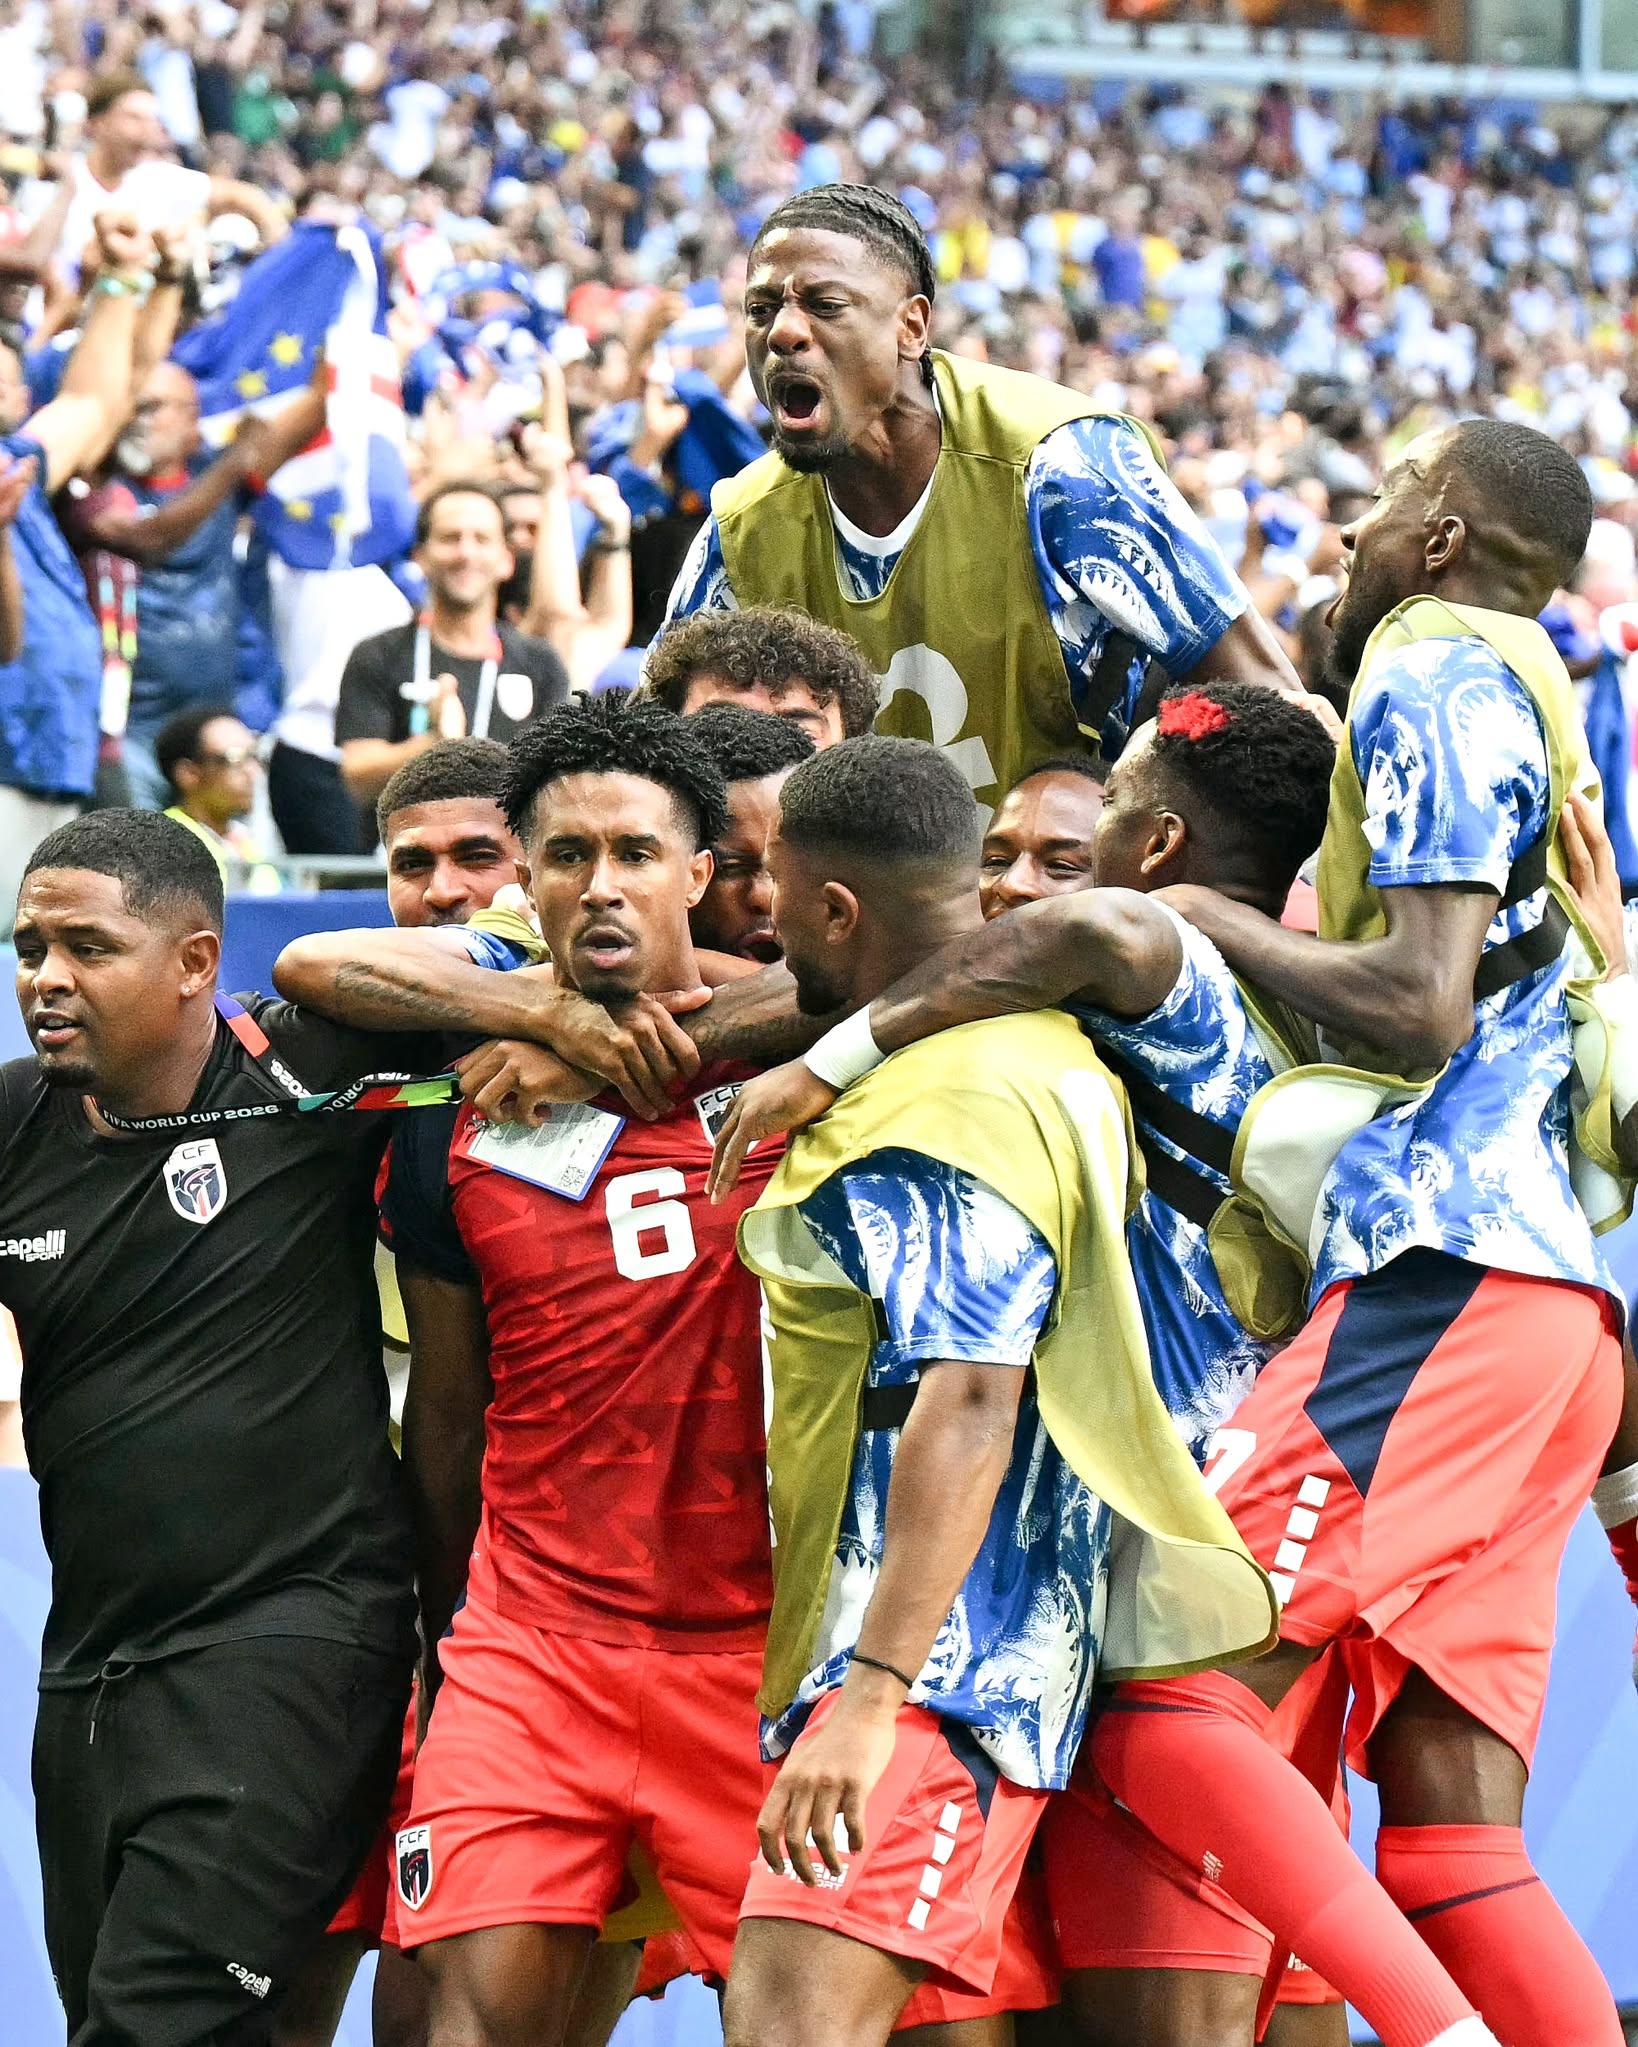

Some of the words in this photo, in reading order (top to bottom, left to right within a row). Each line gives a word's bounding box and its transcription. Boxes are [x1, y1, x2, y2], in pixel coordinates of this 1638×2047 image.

[103, 1109, 130, 1128] FIFA
[131, 1115, 188, 1130] WORLD
[190, 1111, 221, 1124] CUP
[224, 1104, 280, 1120] 2026
[604, 1166, 697, 1282] 6
[25, 1251, 64, 1263] SPORT
[399, 1829, 428, 1848] FCF
[226, 1962, 272, 1994] capelli
